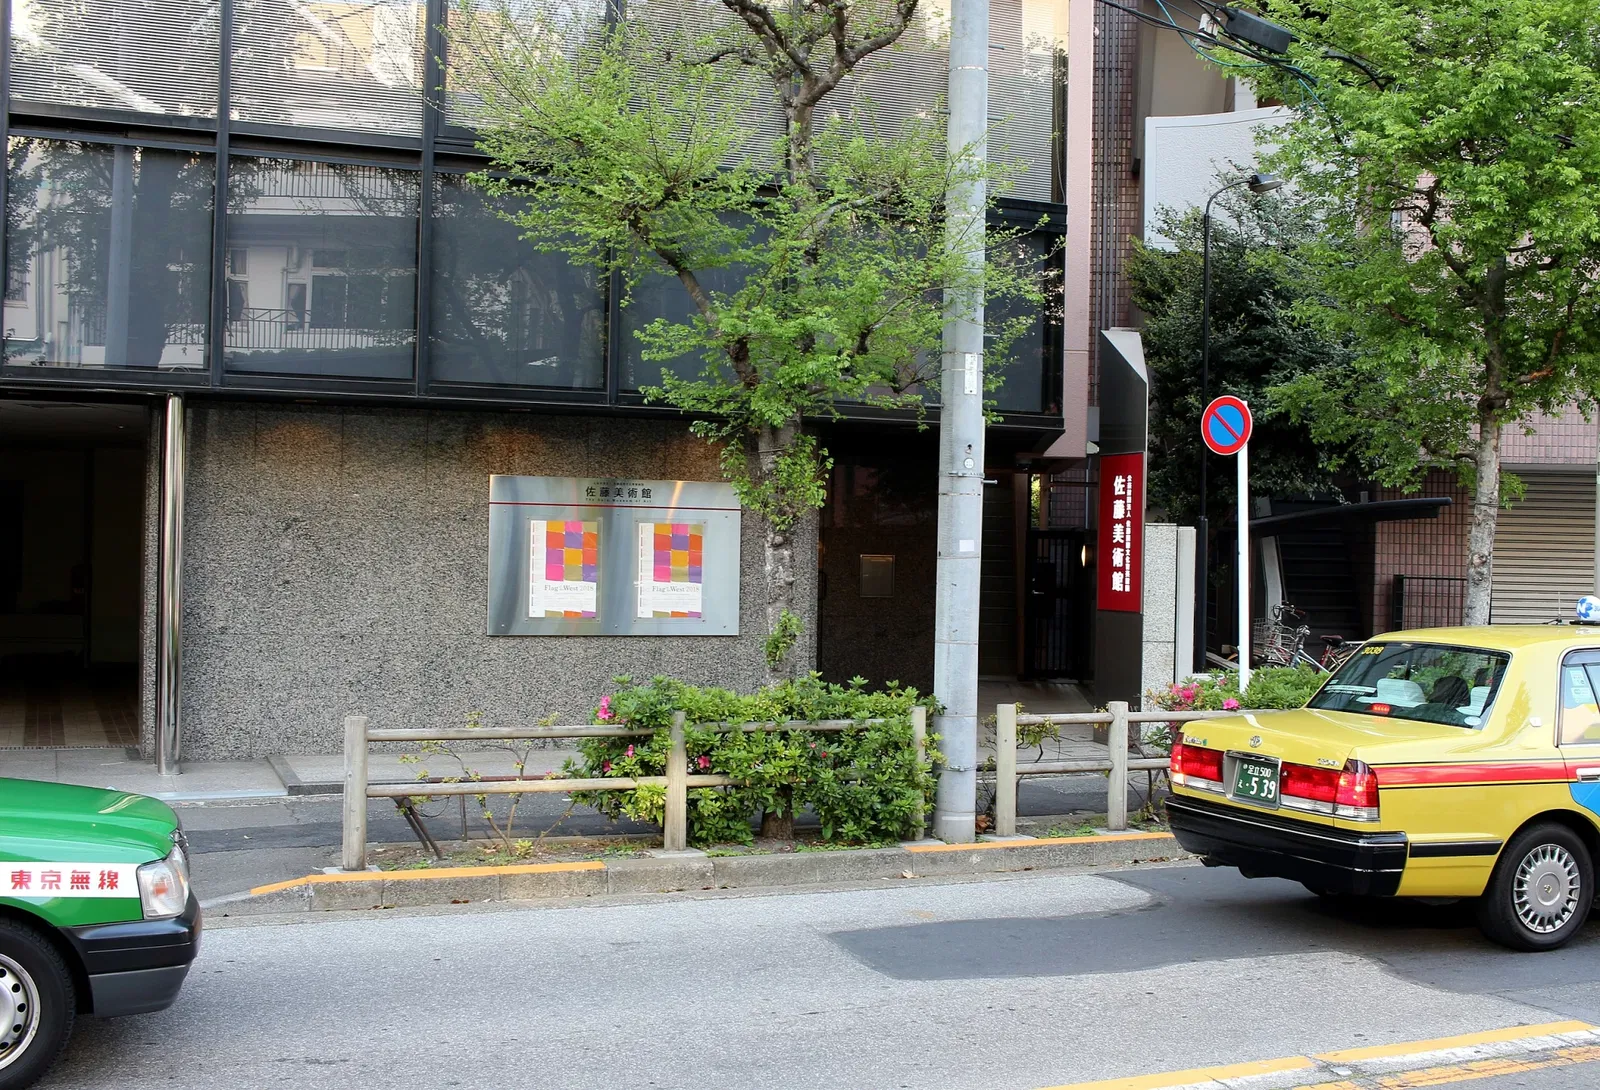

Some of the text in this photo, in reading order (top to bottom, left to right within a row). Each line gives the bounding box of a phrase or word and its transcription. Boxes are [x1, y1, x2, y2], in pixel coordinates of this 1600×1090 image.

[585, 486, 652, 499] 佐藤美術館
[1112, 475, 1126, 591] 佐藤美術館
[544, 584, 558, 592] Flag
[563, 584, 579, 592] West
[652, 585, 666, 593] Flag
[670, 585, 685, 593] West
[1259, 767, 1272, 778] 500
[10, 869, 119, 890] 東京無線
